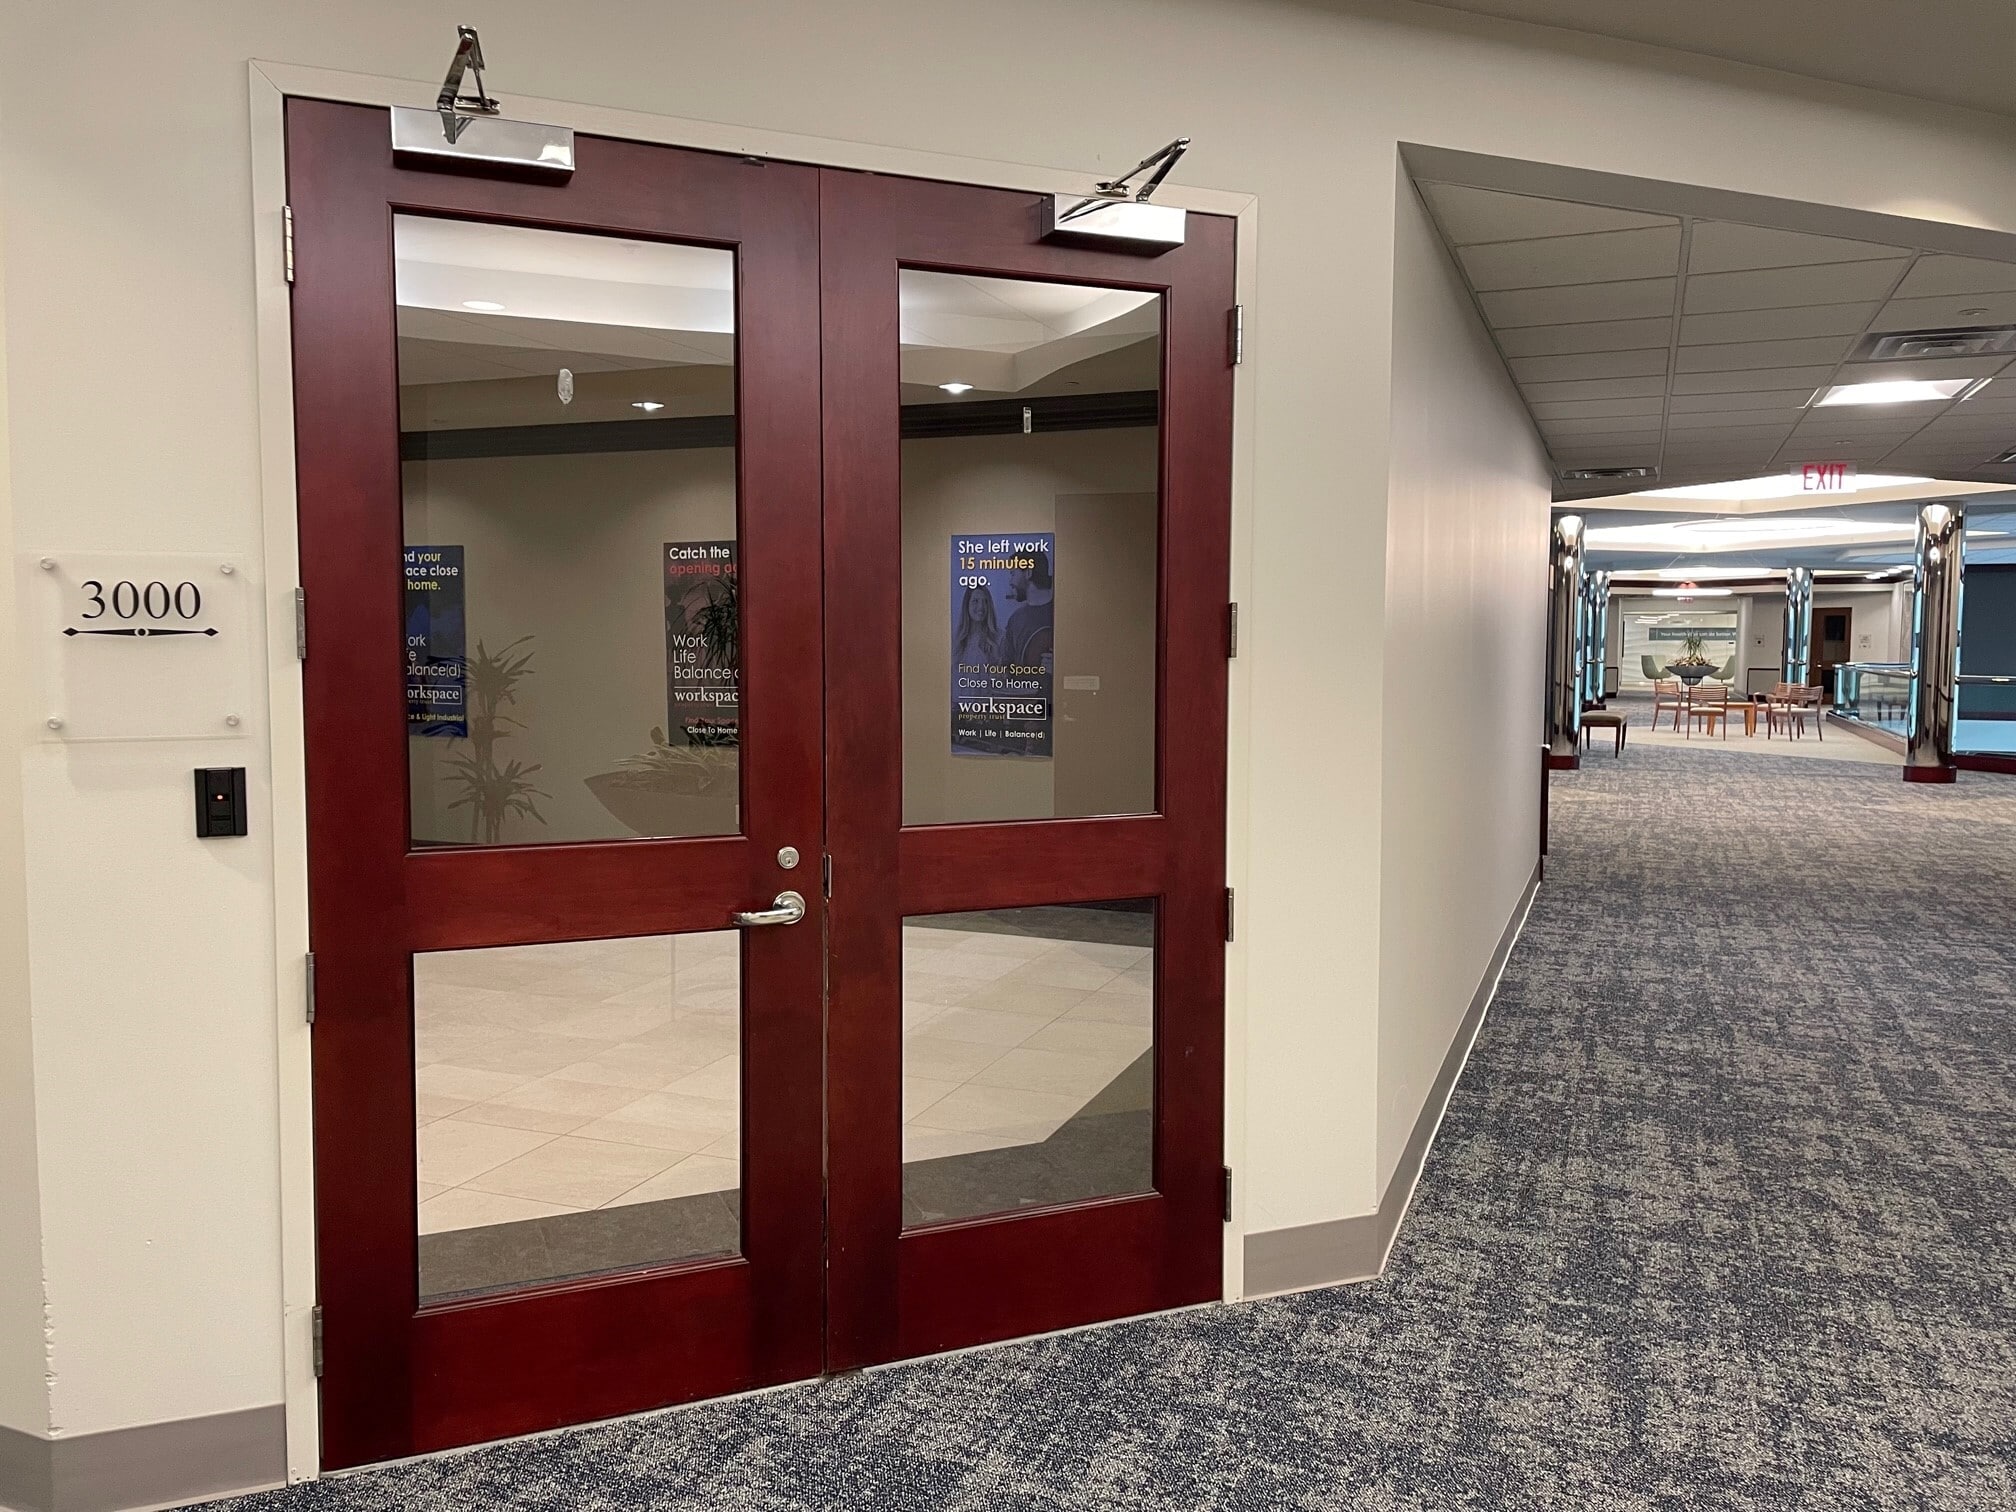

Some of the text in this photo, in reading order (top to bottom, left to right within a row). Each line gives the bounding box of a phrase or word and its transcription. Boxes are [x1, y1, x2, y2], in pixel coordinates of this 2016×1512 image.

[1802, 463, 1848, 490] EXIT
[669, 545, 730, 560] Catch the
[958, 538, 1049, 554] She left work
[417, 552, 441, 565] your
[960, 556, 1035, 570] 15 minutes
[429, 564, 459, 576] close
[669, 561, 720, 576] opening
[407, 578, 441, 591] home.
[958, 575, 991, 590] ago.
[80, 580, 202, 619] 3000
[406, 634, 426, 647] ork
[672, 634, 708, 648] Work
[673, 649, 697, 663] Life
[958, 663, 1046, 676] Find Your Space
[958, 677, 1043, 690] Close To Home.
[958, 697, 1044, 719] workspace
[958, 713, 987, 721] property
[686, 725, 707, 734] Close
[708, 726, 716, 734] To
[958, 728, 977, 737] Work
[984, 729, 997, 738] Life
